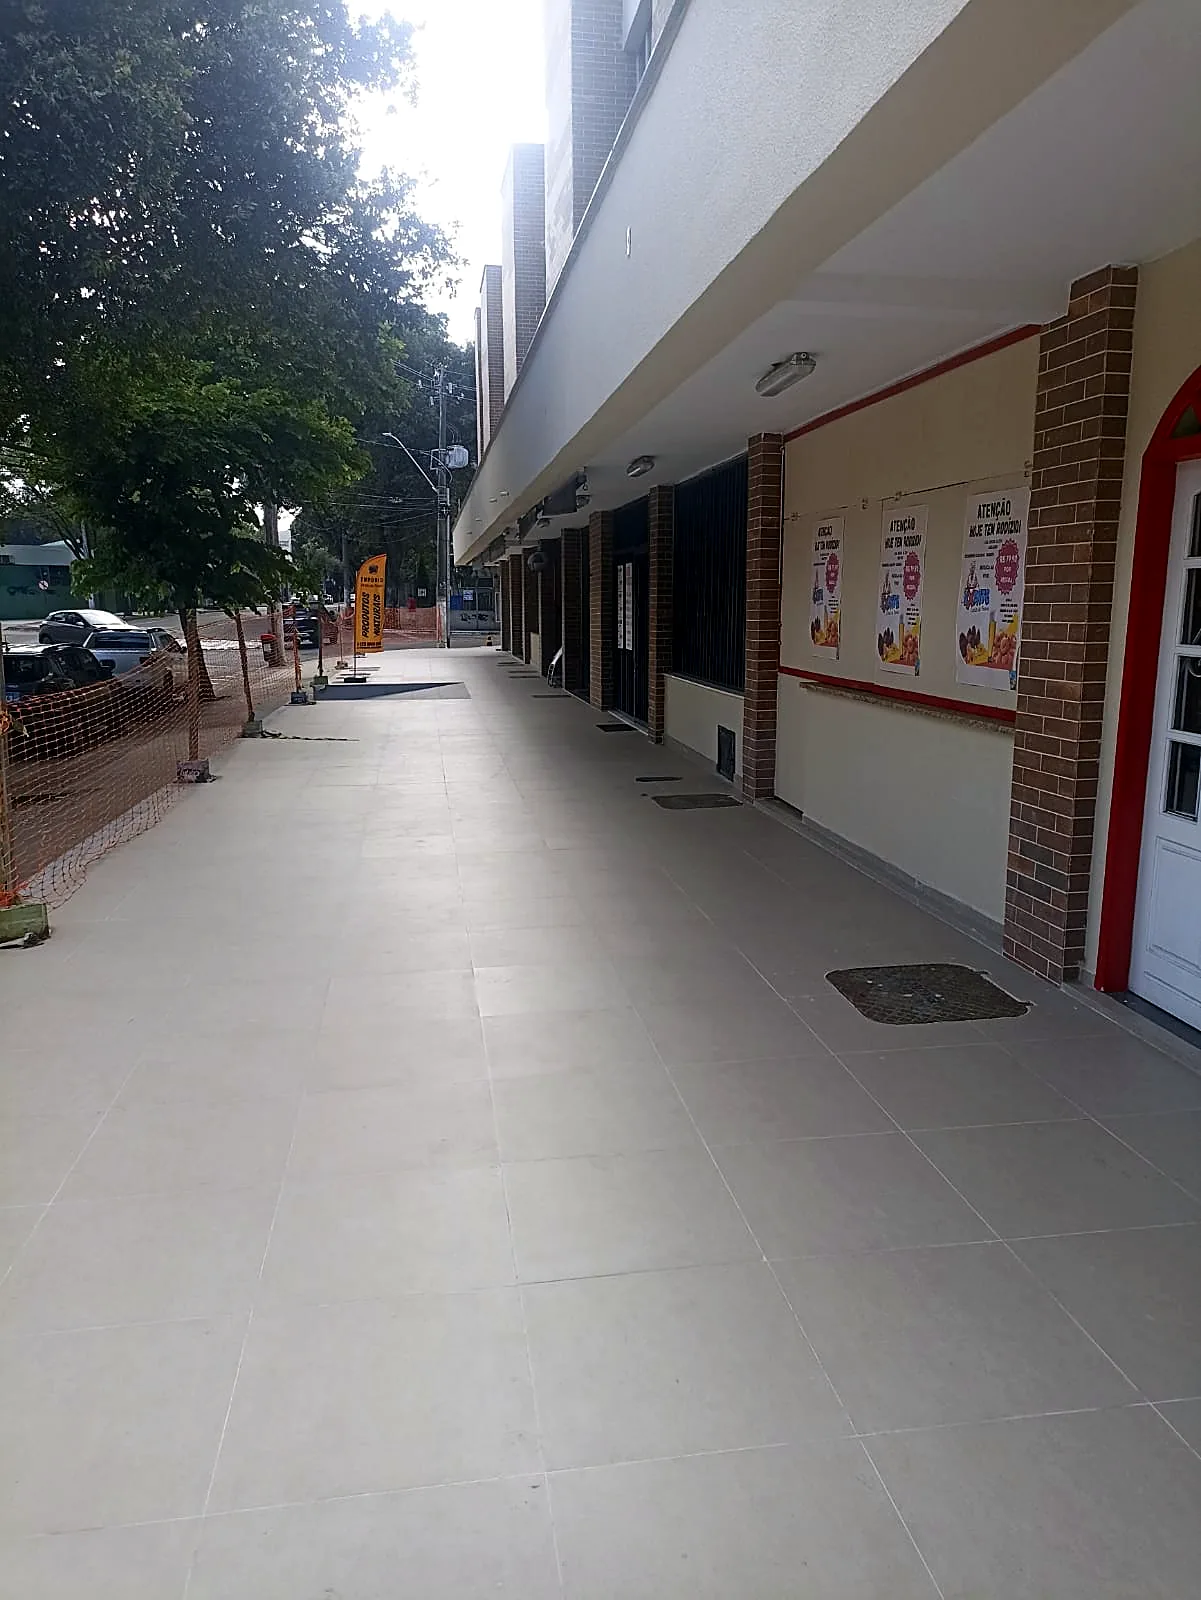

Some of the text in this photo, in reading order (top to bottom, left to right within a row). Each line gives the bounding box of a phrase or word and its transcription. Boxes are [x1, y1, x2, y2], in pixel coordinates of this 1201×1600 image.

[977, 498, 1012, 520] ATENÇÃO
[890, 515, 916, 534] ATENÇÃO
[969, 518, 1022, 537] HOJE TEM RODÍZIO!
[361, 592, 370, 638] PRODUTOS
[373, 593, 381, 637] NATURAIS
